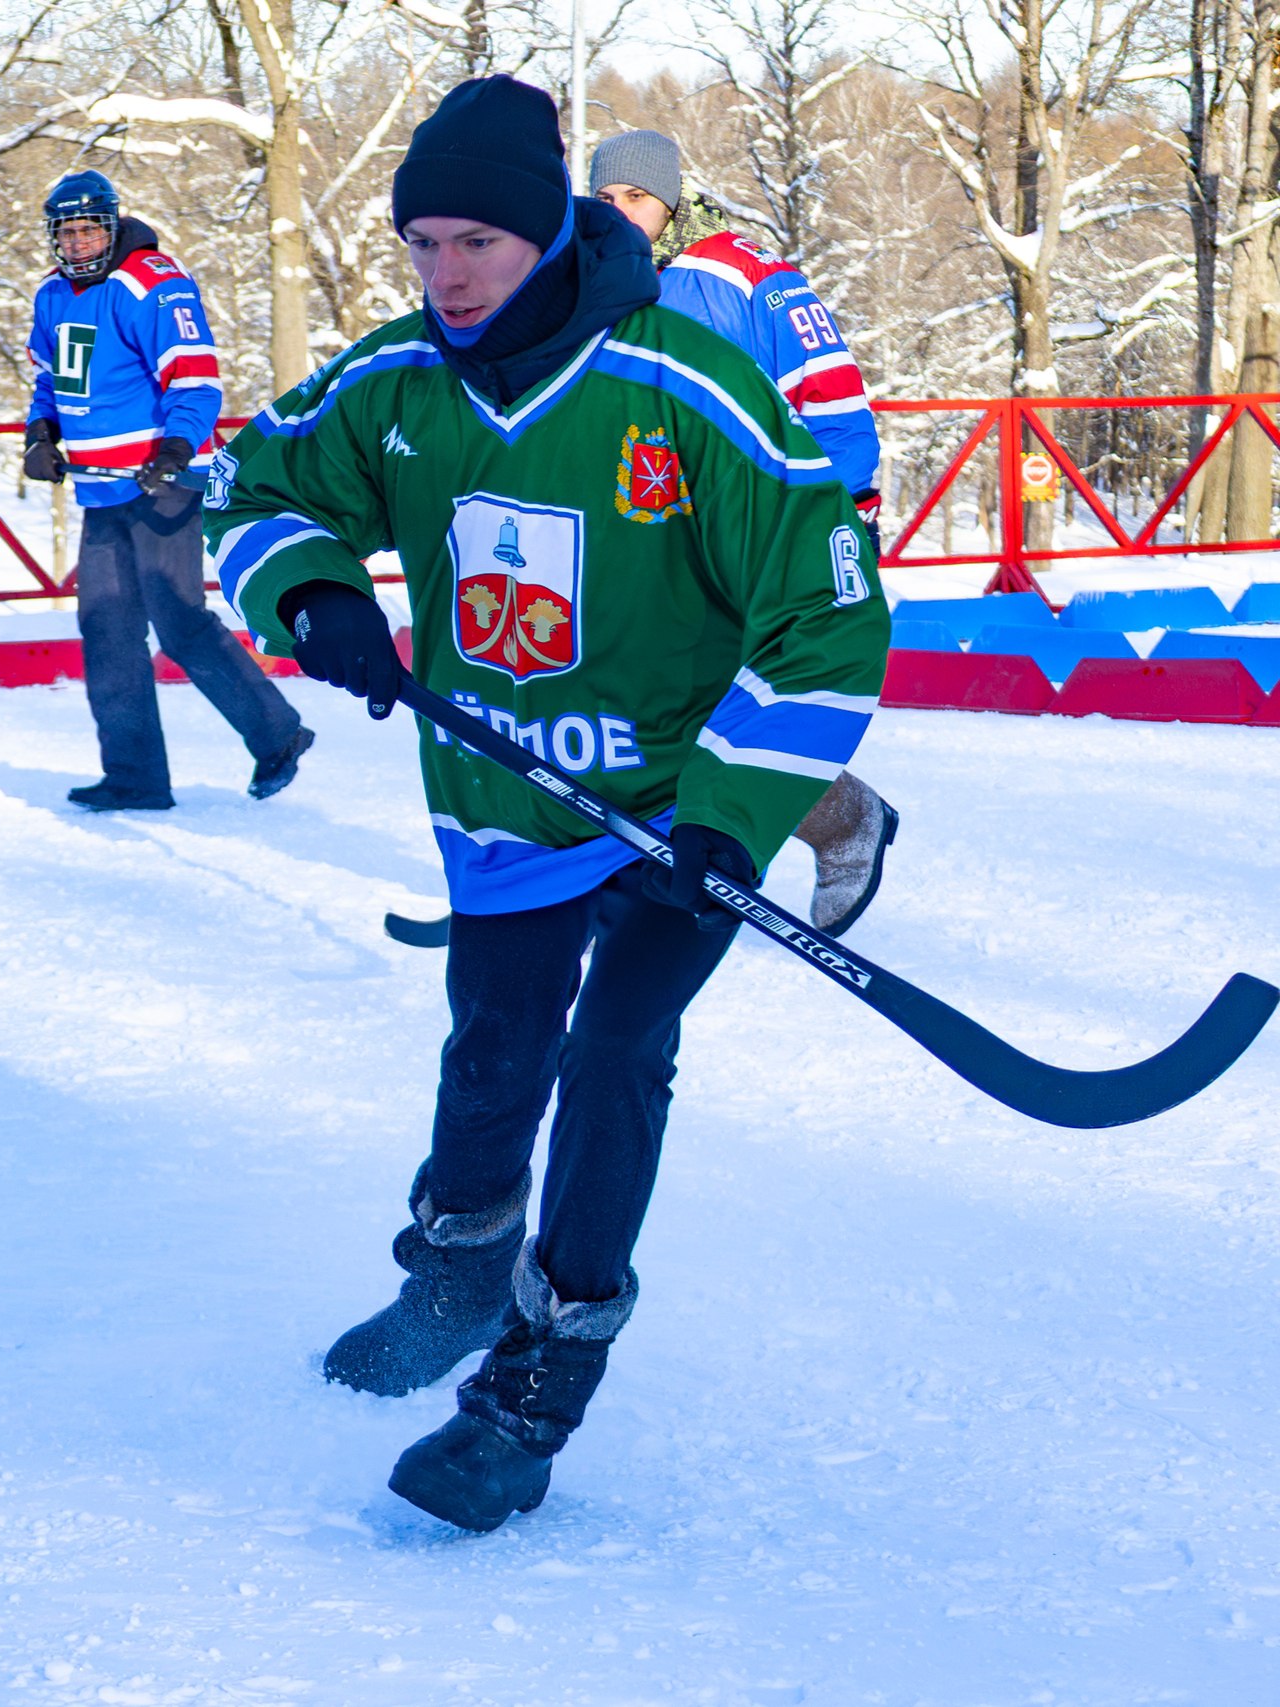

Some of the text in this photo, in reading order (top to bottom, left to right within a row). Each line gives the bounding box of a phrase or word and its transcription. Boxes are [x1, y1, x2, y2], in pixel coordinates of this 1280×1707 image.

[173, 306, 200, 340] 16
[788, 302, 839, 351] 99
[829, 525, 870, 608] 6
[786, 931, 870, 983] RGX
